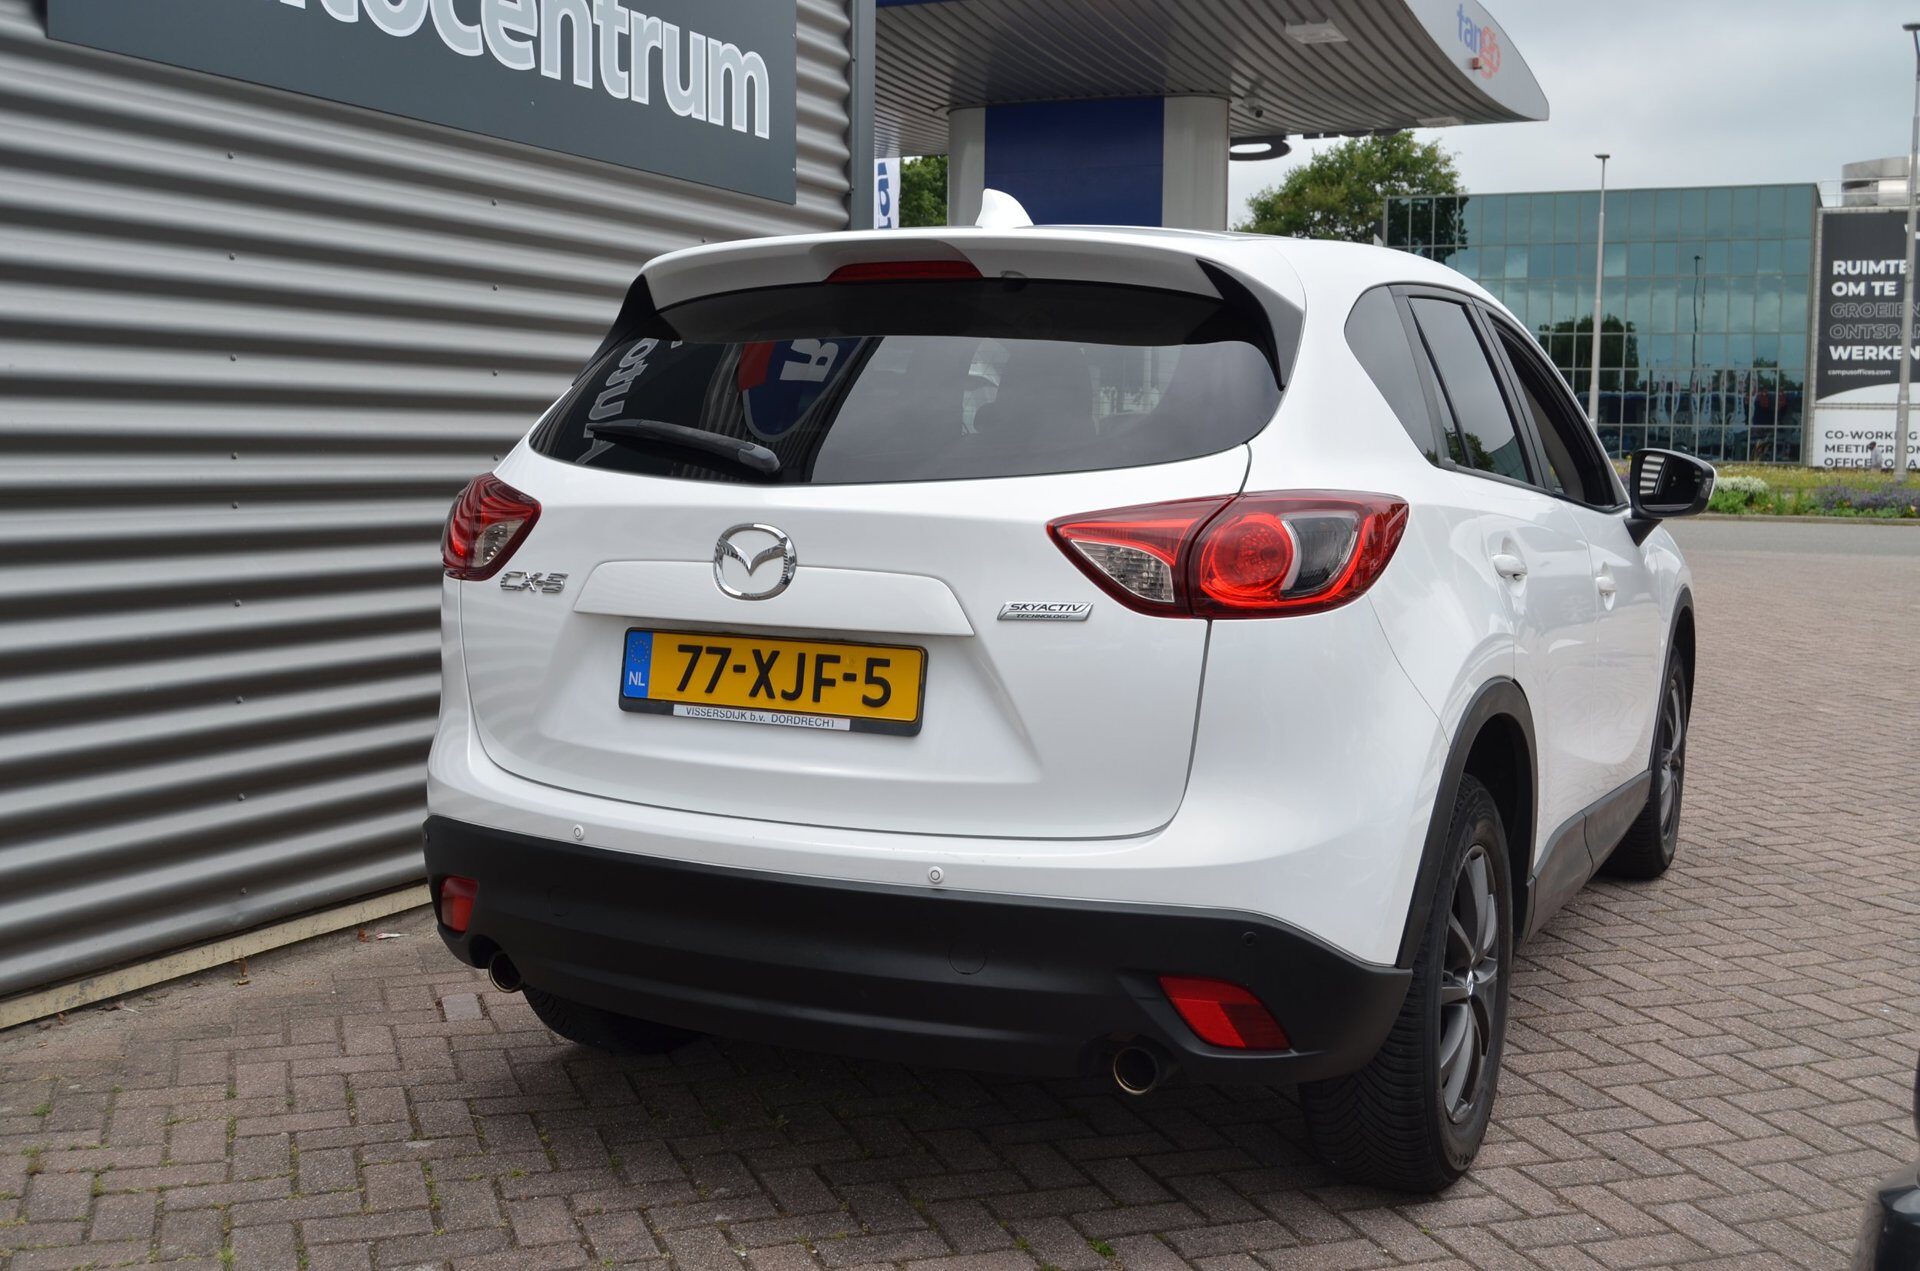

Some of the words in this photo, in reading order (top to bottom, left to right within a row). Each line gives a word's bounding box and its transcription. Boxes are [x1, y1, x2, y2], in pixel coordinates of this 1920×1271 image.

[1832, 260, 1907, 276] RUIMTE
[1831, 281, 1866, 297] OM
[1870, 281, 1897, 297] TE
[500, 571, 569, 593] CX-5
[1009, 603, 1083, 612] SKYACTIV
[628, 671, 645, 687] NL
[676, 644, 892, 708] 77-XJF-5
[686, 707, 747, 720] VISSERSDIJK
[750, 712, 766, 722] b.v.
